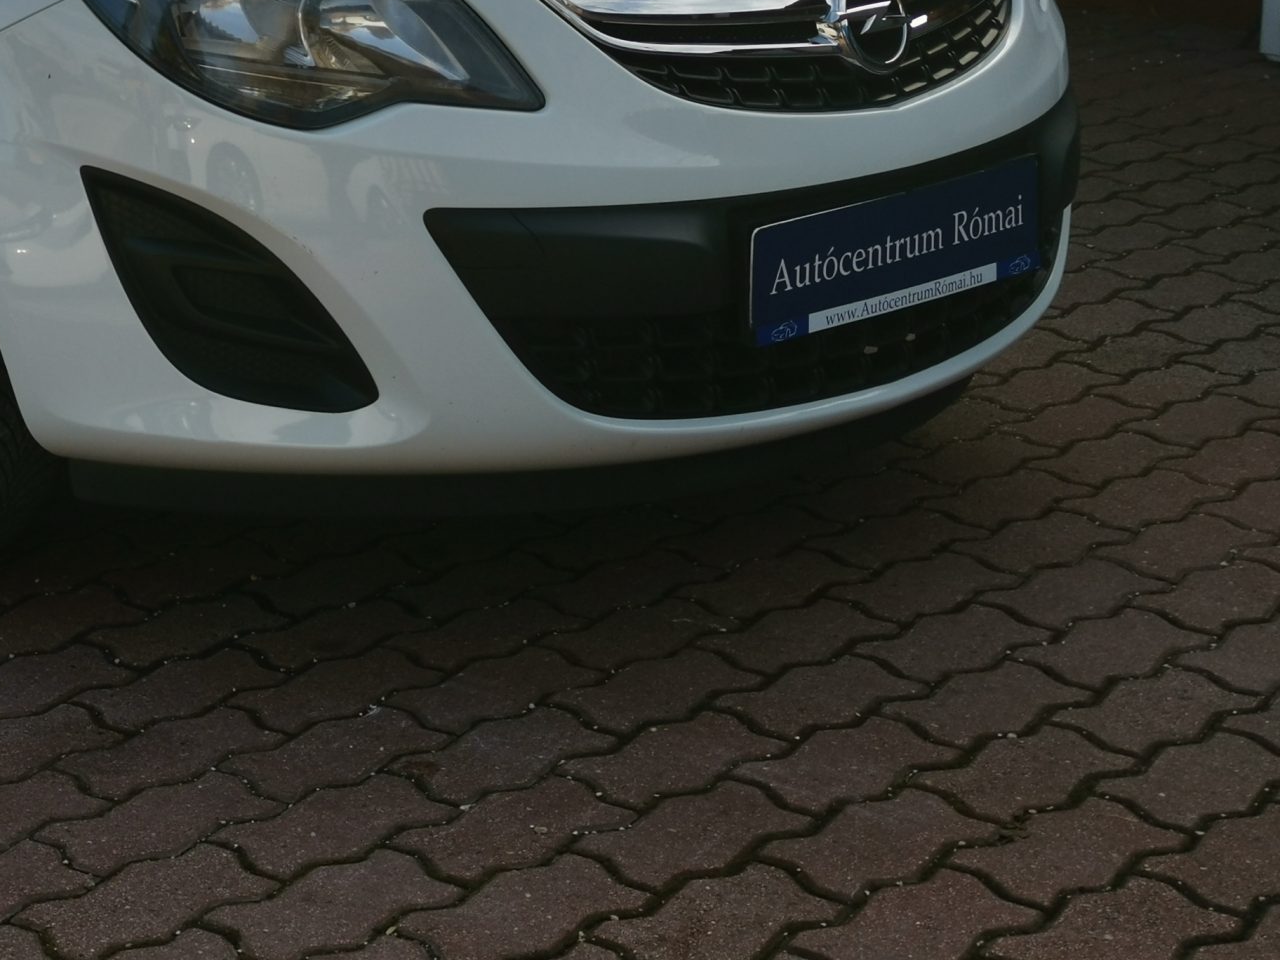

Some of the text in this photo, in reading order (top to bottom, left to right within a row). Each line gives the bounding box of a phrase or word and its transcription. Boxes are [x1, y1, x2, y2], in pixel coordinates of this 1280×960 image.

[769, 193, 1025, 296] Autócentrum Római
[824, 270, 984, 327] www.AutócentrumRómai.hu
